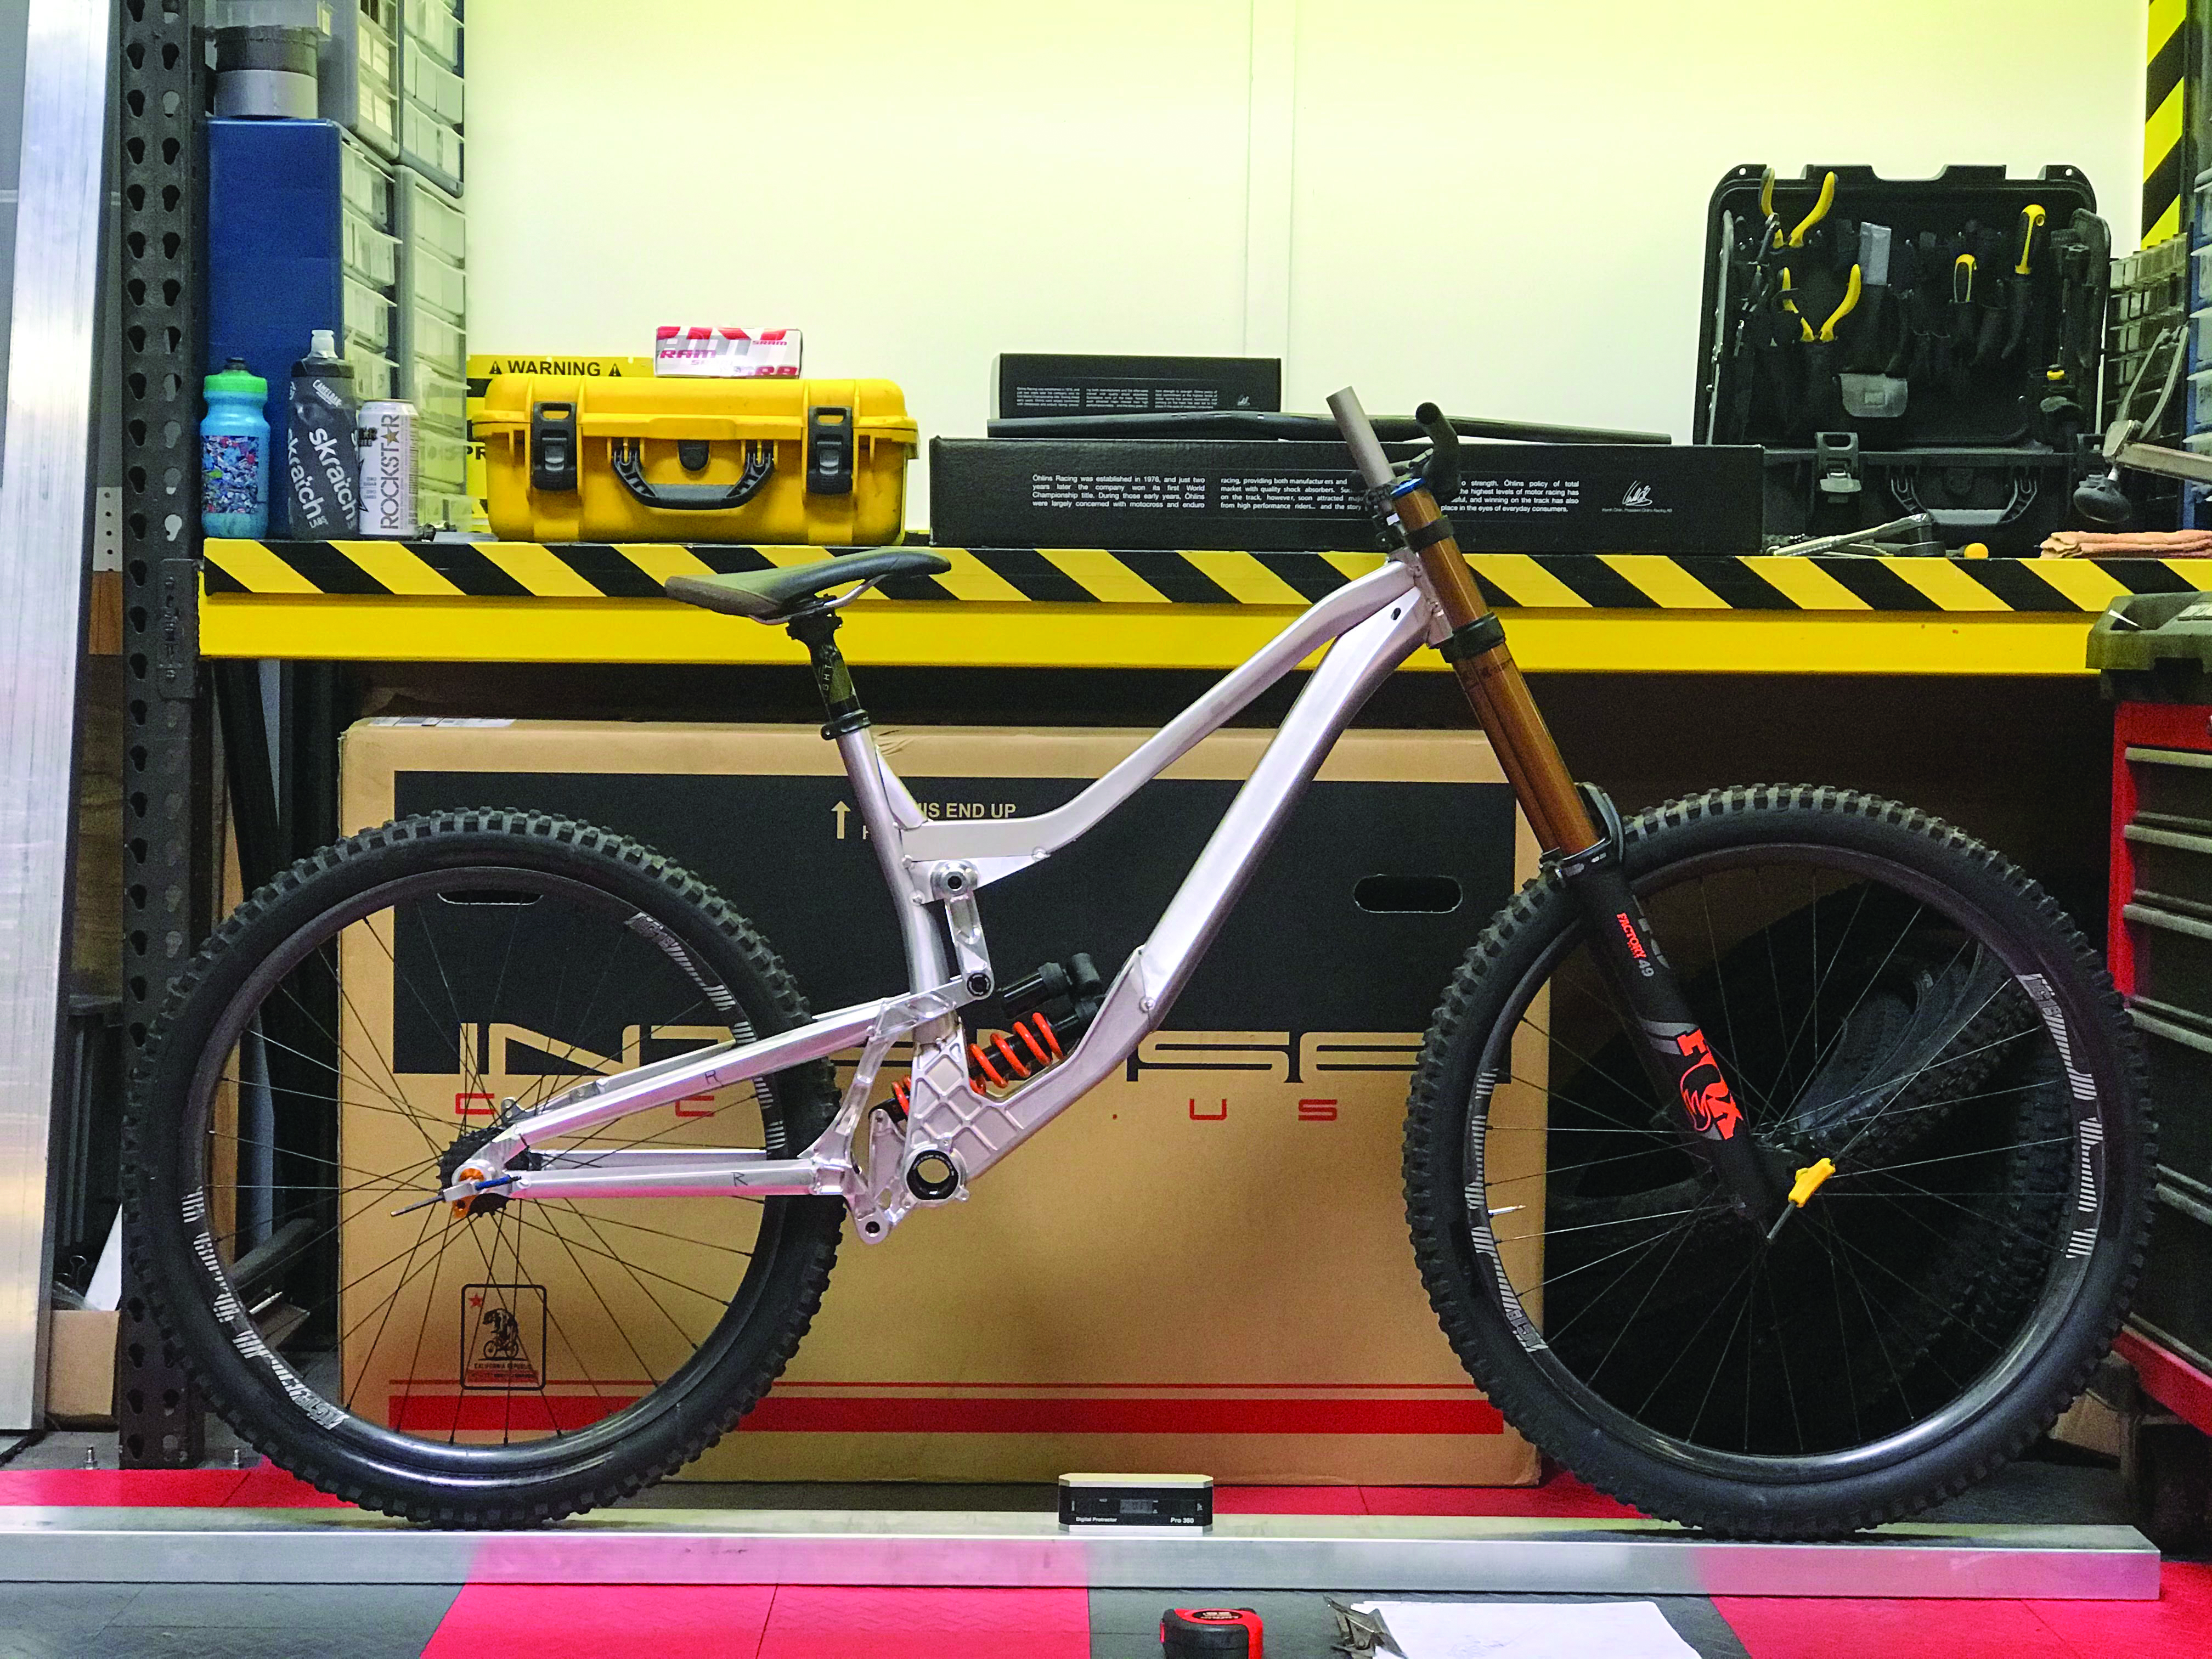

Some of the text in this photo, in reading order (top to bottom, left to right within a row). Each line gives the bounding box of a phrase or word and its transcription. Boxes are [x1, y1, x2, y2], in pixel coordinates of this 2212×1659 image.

[658, 349, 716, 358] RAM
[507, 360, 601, 376] WARNING
[309, 427, 357, 520] skratch
[1055, 475, 1078, 483] Racing
[1243, 477, 1272, 486] providing
[1032, 491, 1079, 499] Championship
[1098, 492, 1120, 500] During
[1237, 502, 1251, 510] high
[918, 803, 1017, 818] IS END UP
[1616, 912, 1654, 977] FACTORY 49
